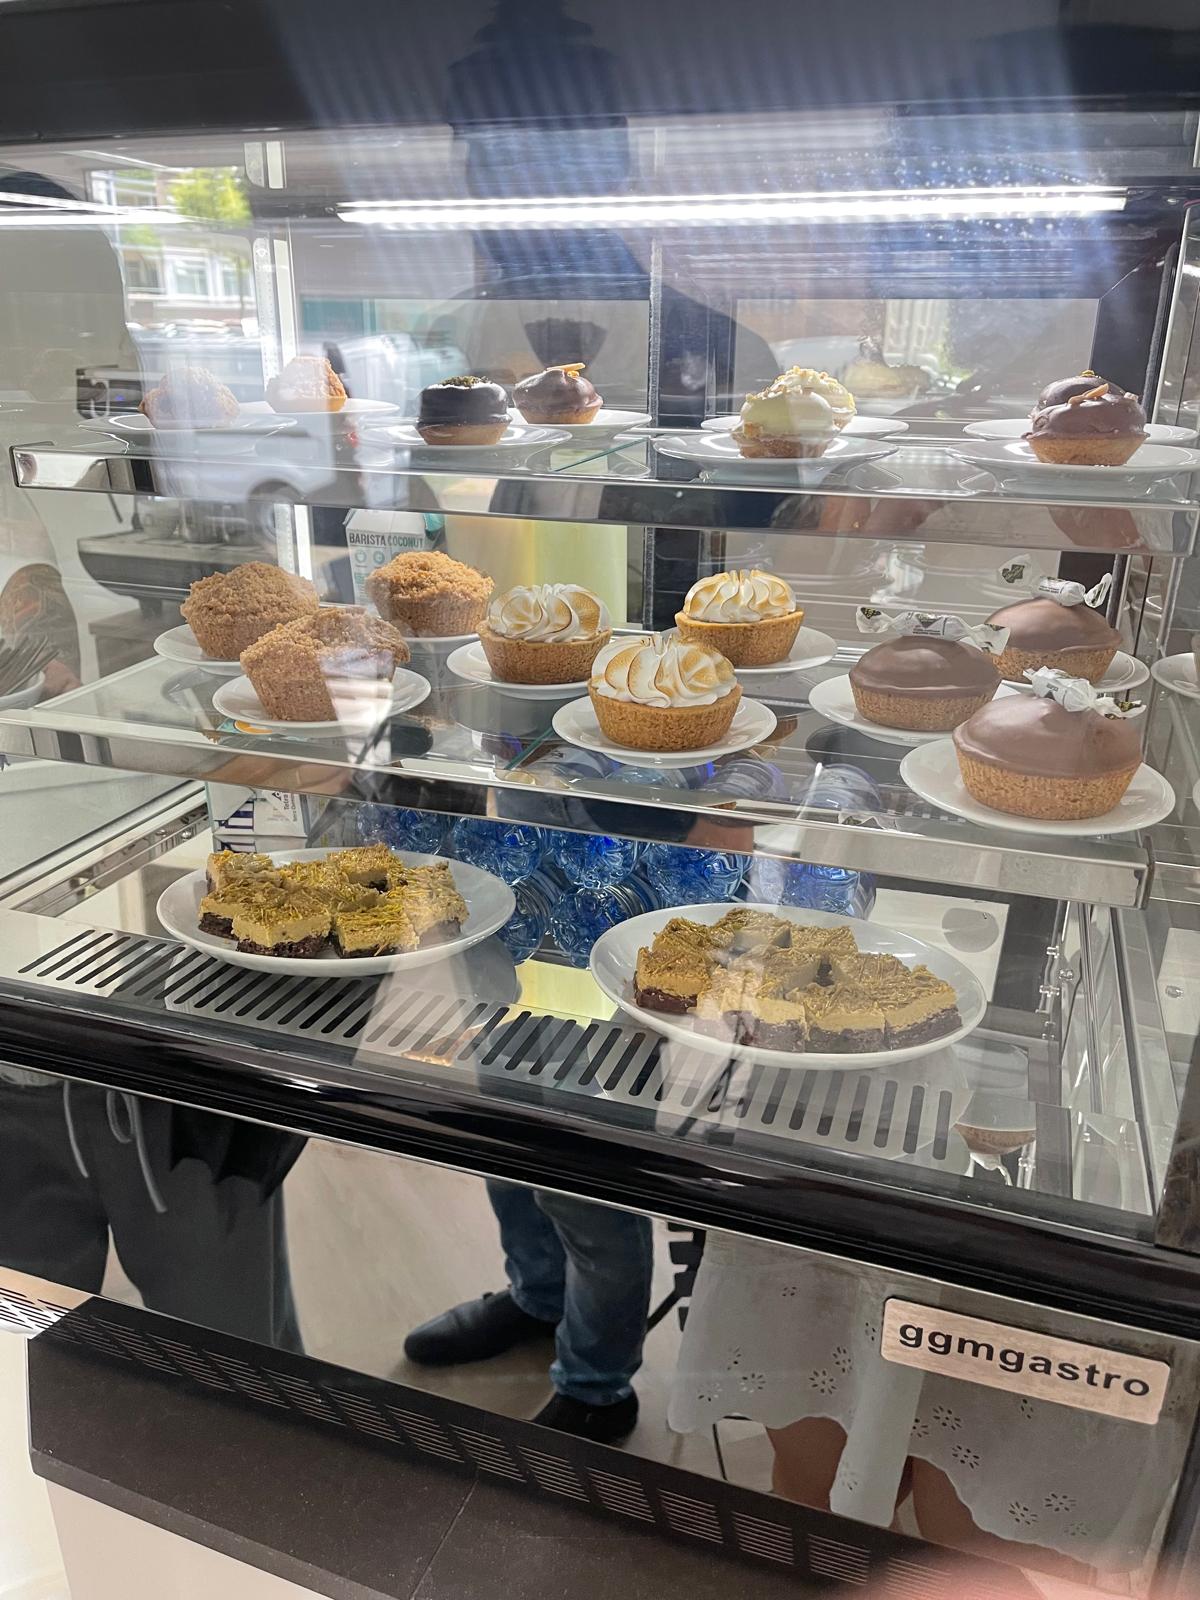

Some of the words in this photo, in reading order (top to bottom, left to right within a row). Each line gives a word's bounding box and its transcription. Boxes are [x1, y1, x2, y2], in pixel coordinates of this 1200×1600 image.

[350, 533, 386, 546] BARISTA
[388, 536, 424, 548] COCONUT
[899, 1323, 1150, 1397] ggmgastro
